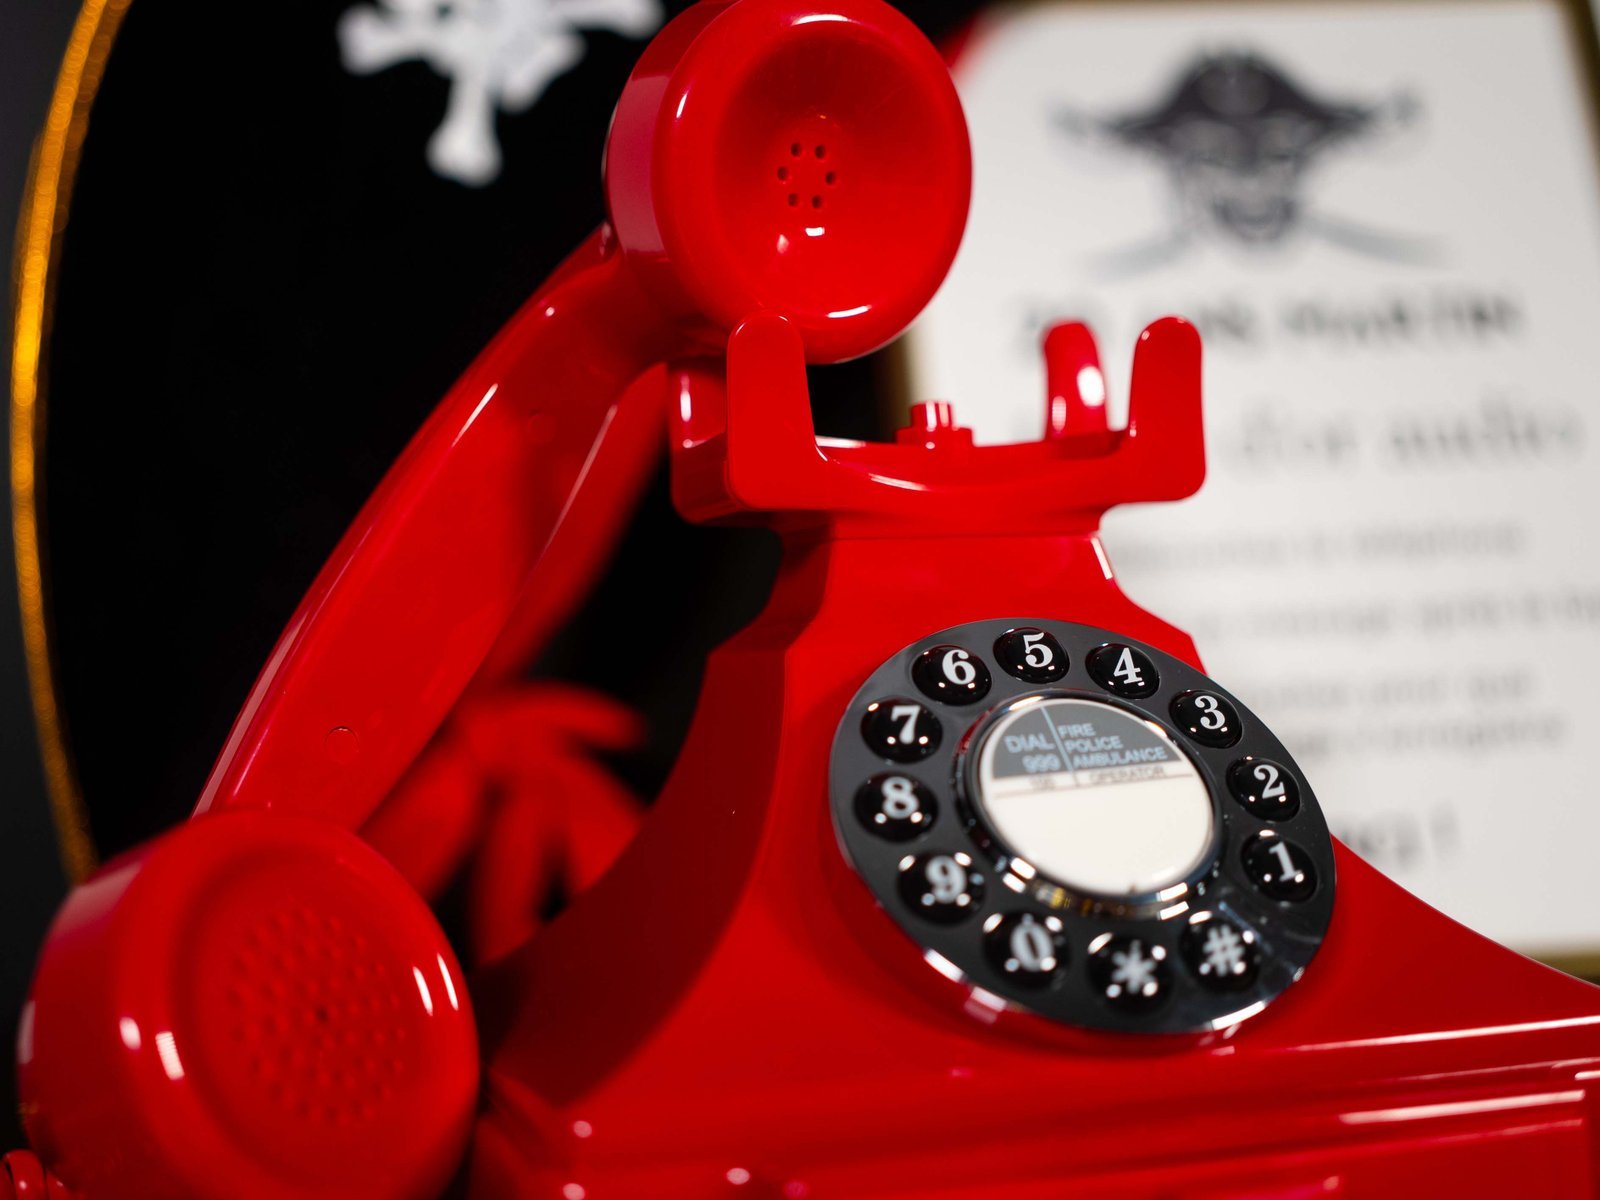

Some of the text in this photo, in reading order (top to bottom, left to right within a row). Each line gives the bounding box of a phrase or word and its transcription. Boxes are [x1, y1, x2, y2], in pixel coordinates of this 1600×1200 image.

[942, 648, 977, 686] 6
[1023, 633, 1055, 668] 5
[1112, 647, 1143, 685] 4
[891, 705, 920, 744] 7
[1058, 722, 1096, 738] FIRE
[1194, 694, 1226, 730] 3
[1004, 732, 1056, 753] DIAL
[1065, 735, 1124, 753] POLICE
[1072, 746, 1168, 768] AMBULANCE
[1022, 754, 1061, 773] 999
[1088, 765, 1166, 784] OPERATOR
[1253, 763, 1286, 800] 2
[881, 776, 920, 819] 8
[925, 854, 967, 902] 9
[1268, 842, 1301, 881] 1
[1010, 914, 1055, 970] 0
